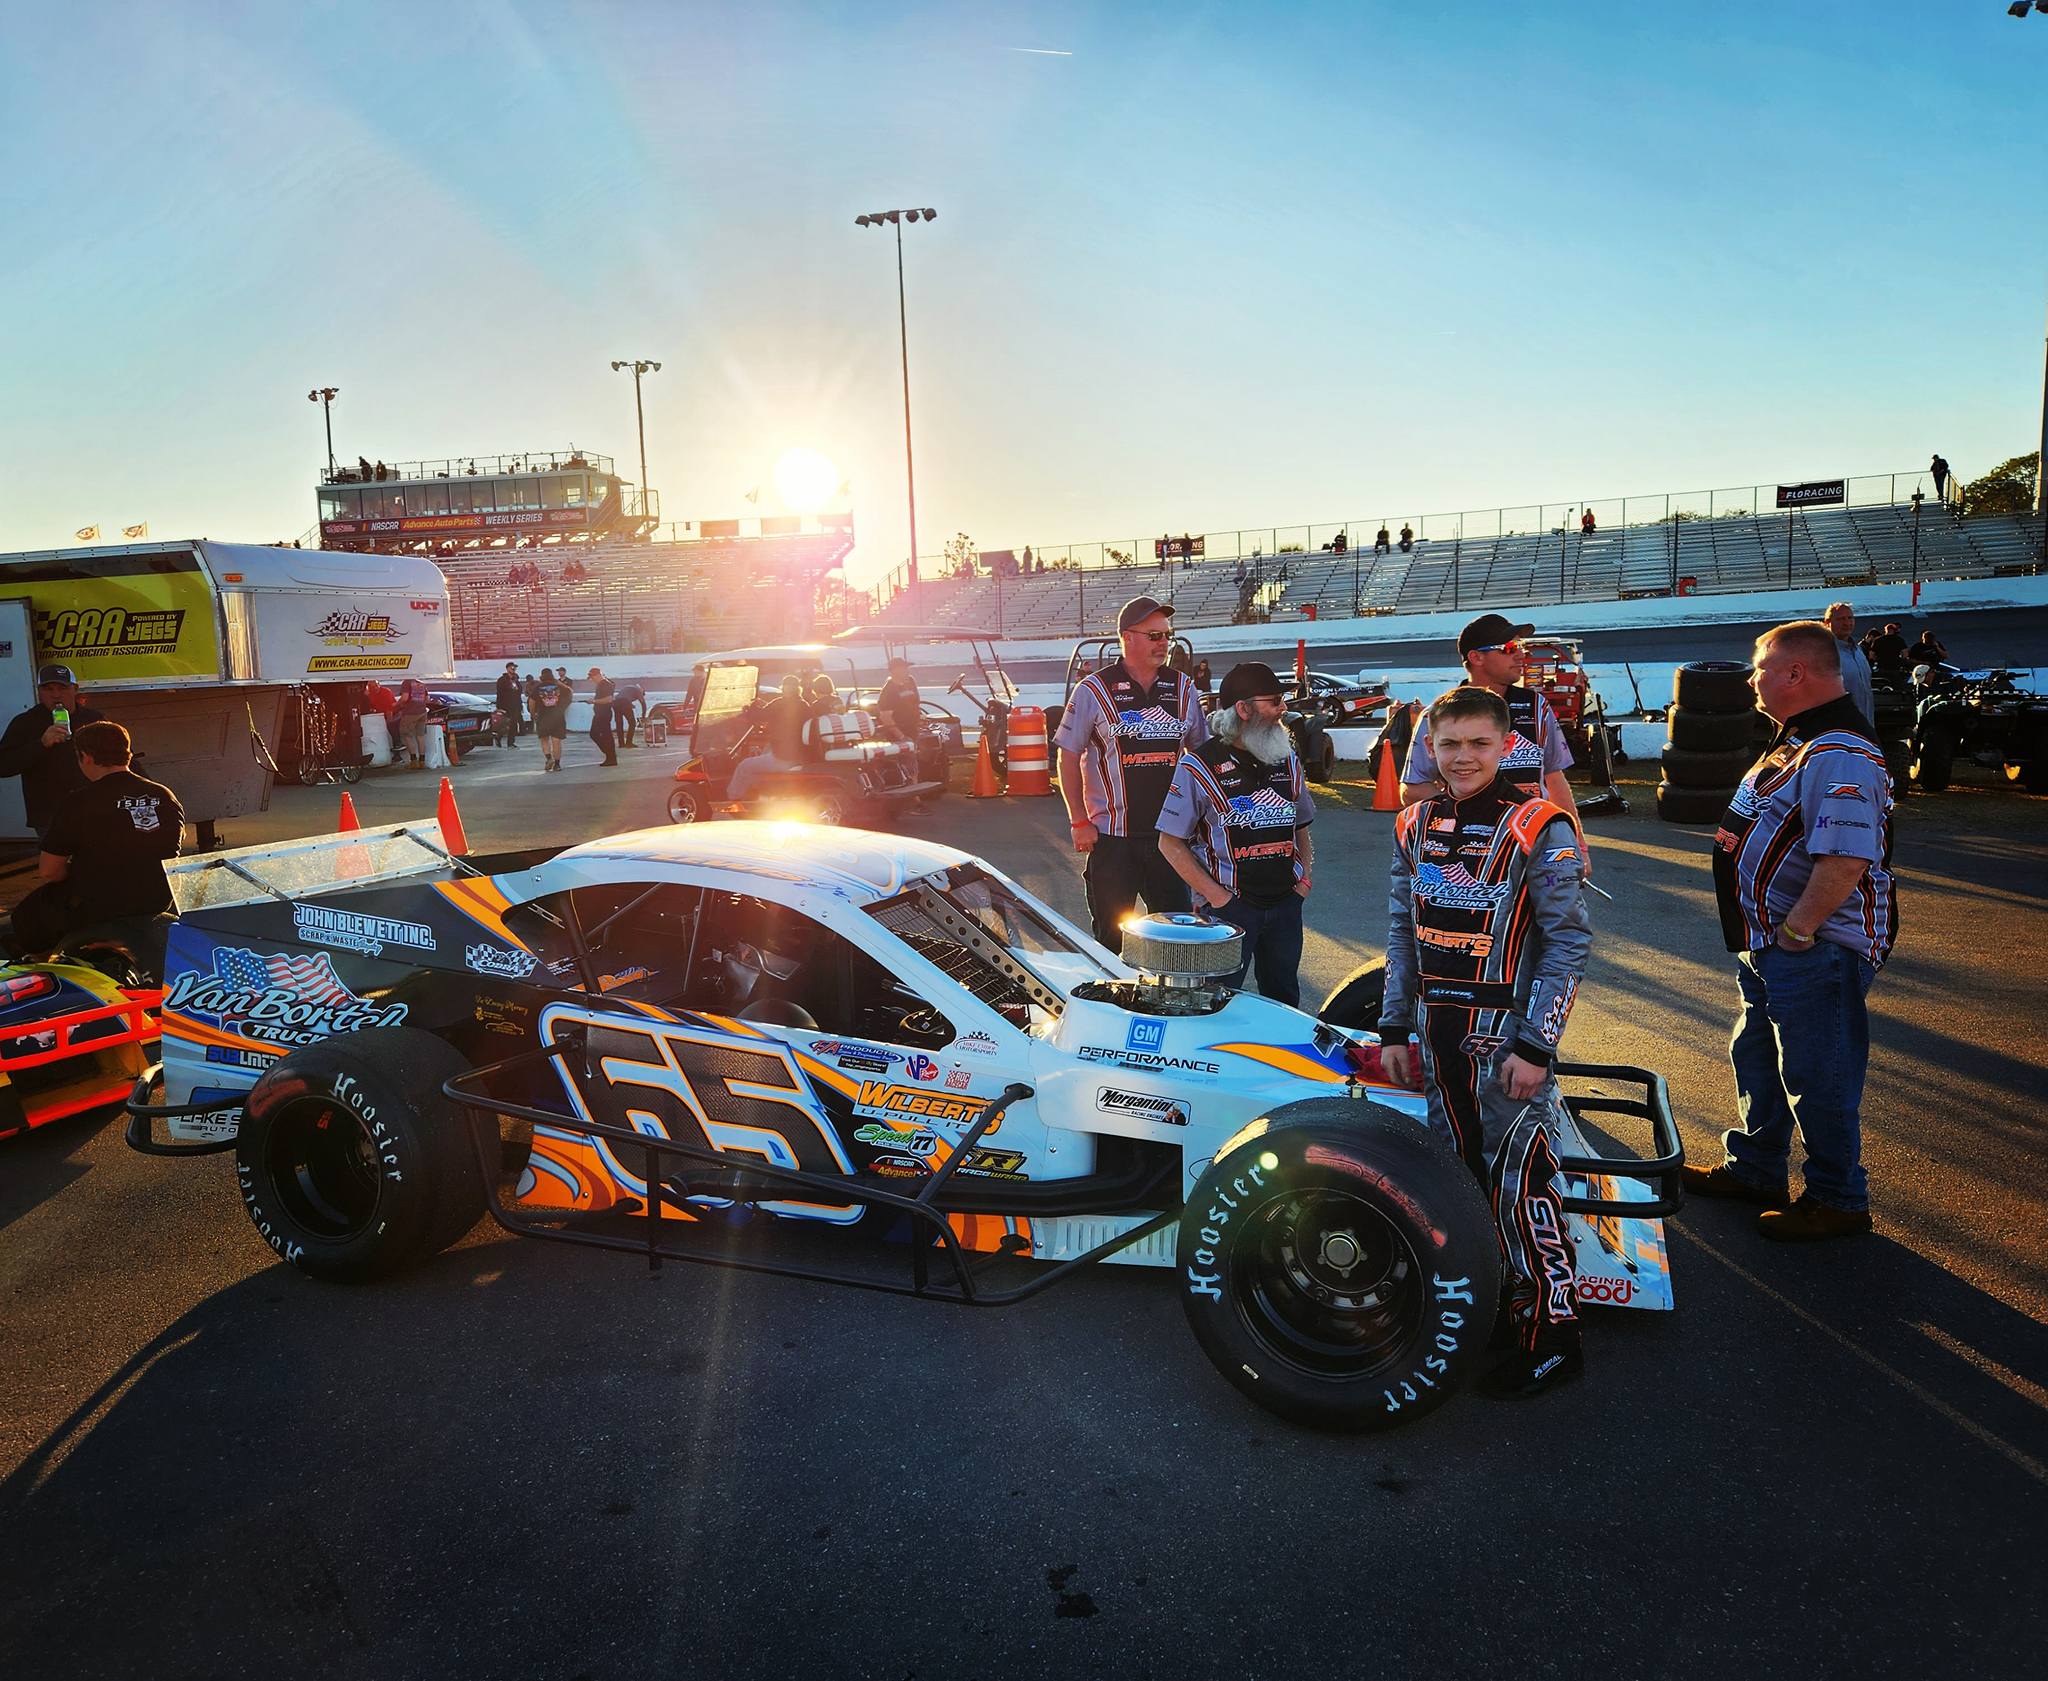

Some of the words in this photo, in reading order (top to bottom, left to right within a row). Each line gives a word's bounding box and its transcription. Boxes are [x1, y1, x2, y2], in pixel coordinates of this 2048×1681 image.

[1785, 486, 1842, 499] FLORACING
[371, 522, 399, 532] NASCAR
[403, 516, 434, 529] Advance
[434, 515, 452, 527] Auto
[452, 513, 475, 526] Parts
[485, 512, 515, 525] WEEKLY
[515, 512, 543, 524] SERIES
[132, 614, 165, 622] POWERED
[338, 613, 368, 631] CRA
[52, 609, 127, 649] CRA
[126, 621, 178, 641] JEGS
[38, 650, 73, 660] MPION
[75, 648, 109, 657] RACING
[111, 644, 177, 656] ASSOCIATION
[314, 657, 407, 668] WWW.CRA-RACING.COM
[296, 906, 335, 931] JOHN
[336, 911, 401, 941] BLEWETT
[402, 924, 433, 947] INC.
[300, 928, 324, 941] SCRAP
[334, 933, 359, 947] WASTE
[479, 960, 519, 973] COBRA
[1133, 1024, 1160, 1043] GM
[1460, 1034, 1509, 1058] 65
[907, 1054, 929, 1080] VP
[1078, 1046, 1221, 1074] PERFORMANCE
[955, 1071, 970, 1083] ROC
[1099, 1089, 1174, 1113] Morgantini
[538, 1001, 866, 1224] 65
[861, 1108, 937, 1126] U-PULL
[327, 1072, 403, 1183] Hoosier
[854, 1124, 914, 1146] Speed
[913, 1135, 932, 1151] 77
[893, 1158, 914, 1168] NASCAR
[238, 1160, 305, 1267] Hoosier
[1188, 1163, 1265, 1305] Hoosier
[1572, 1276, 1625, 1287] ACING
[1577, 1279, 1632, 1304] ood
[1383, 1271, 1474, 1412] Hoosier
